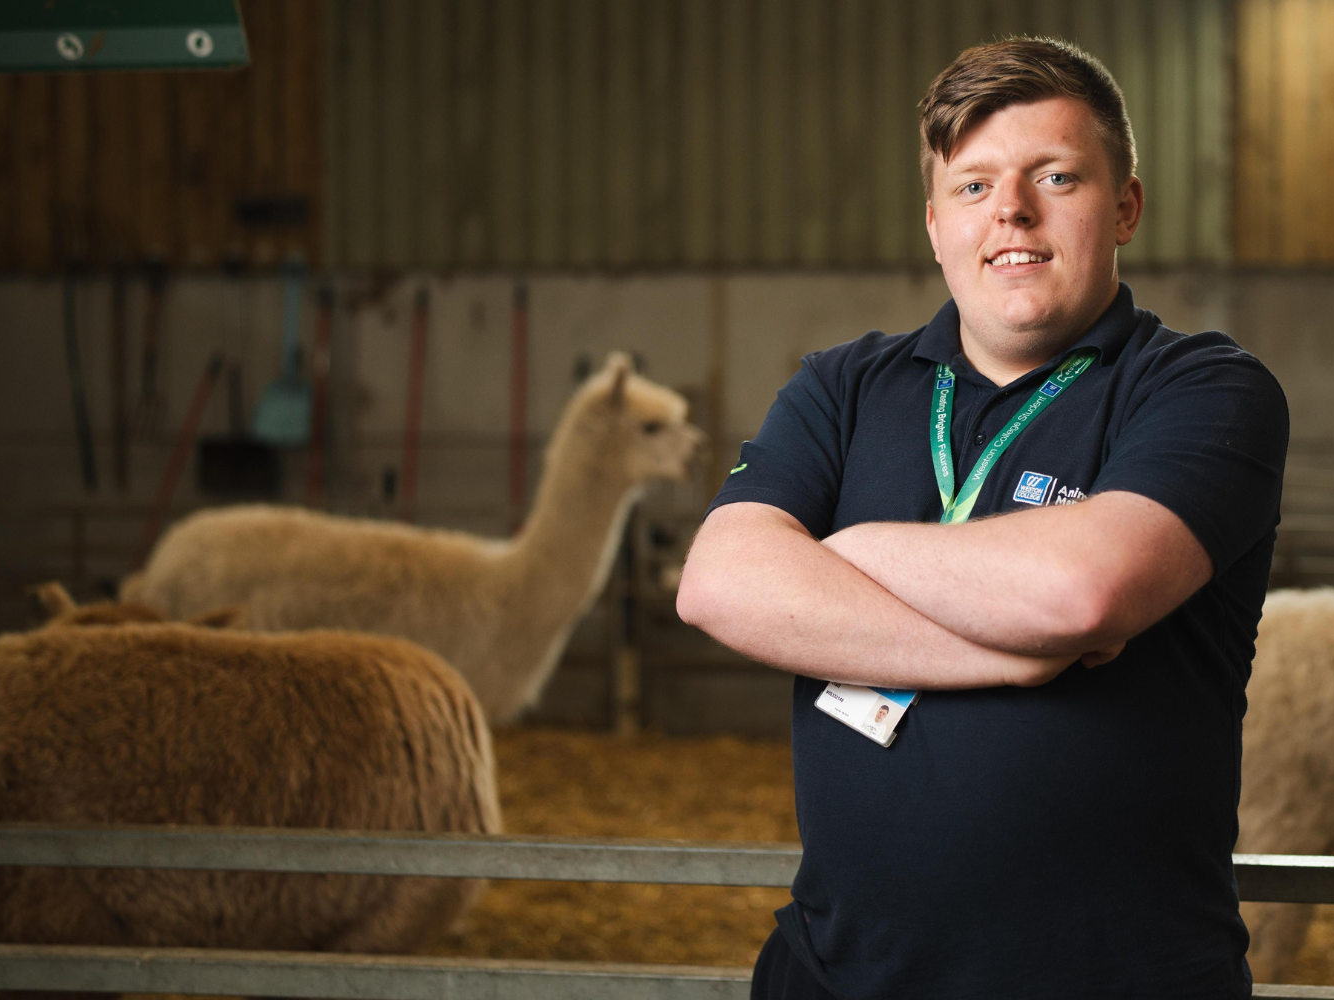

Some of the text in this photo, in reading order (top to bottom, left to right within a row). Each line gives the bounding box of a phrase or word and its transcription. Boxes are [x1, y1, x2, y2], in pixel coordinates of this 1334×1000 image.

[936, 389, 949, 413] Creating
[935, 413, 946, 442] Brighter
[972, 396, 1047, 480] Weston College Student
[938, 443, 949, 477] Futures
[1017, 491, 1041, 501] COLLEGE
[1020, 485, 1043, 494] WESTON
